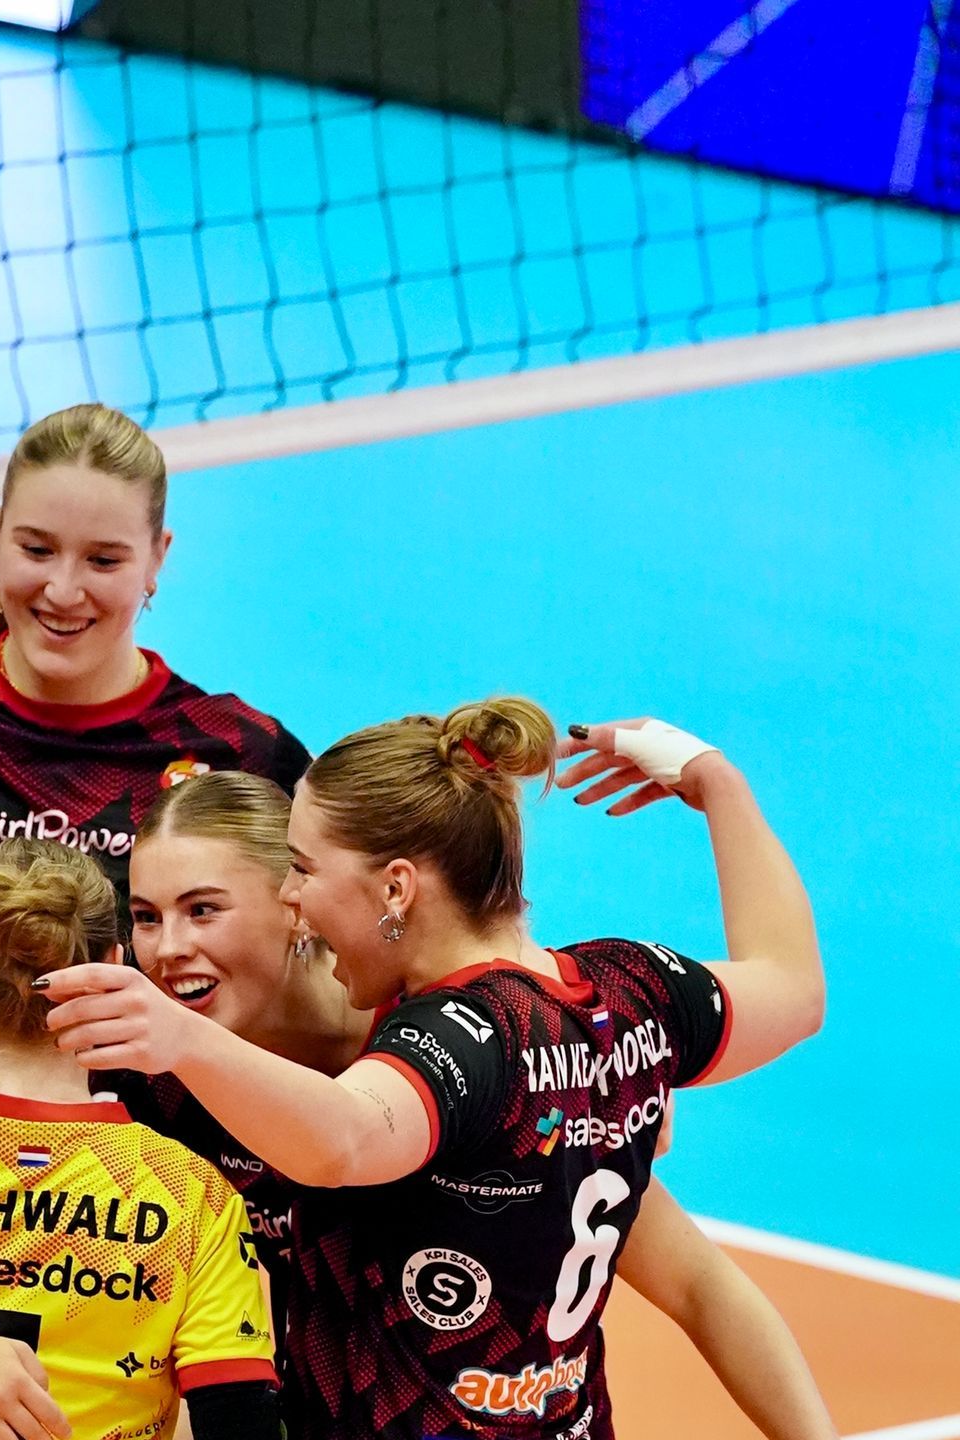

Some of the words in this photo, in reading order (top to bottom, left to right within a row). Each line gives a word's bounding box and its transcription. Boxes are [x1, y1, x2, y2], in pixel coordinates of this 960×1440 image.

[431, 1174, 544, 1197] MASTERMATE
[424, 1251, 447, 1261] KPI
[449, 1253, 487, 1283] SALES
[547, 1169, 631, 1342] 6
[405, 1285, 437, 1325] SALES
[438, 1310, 475, 1328] CLUB
